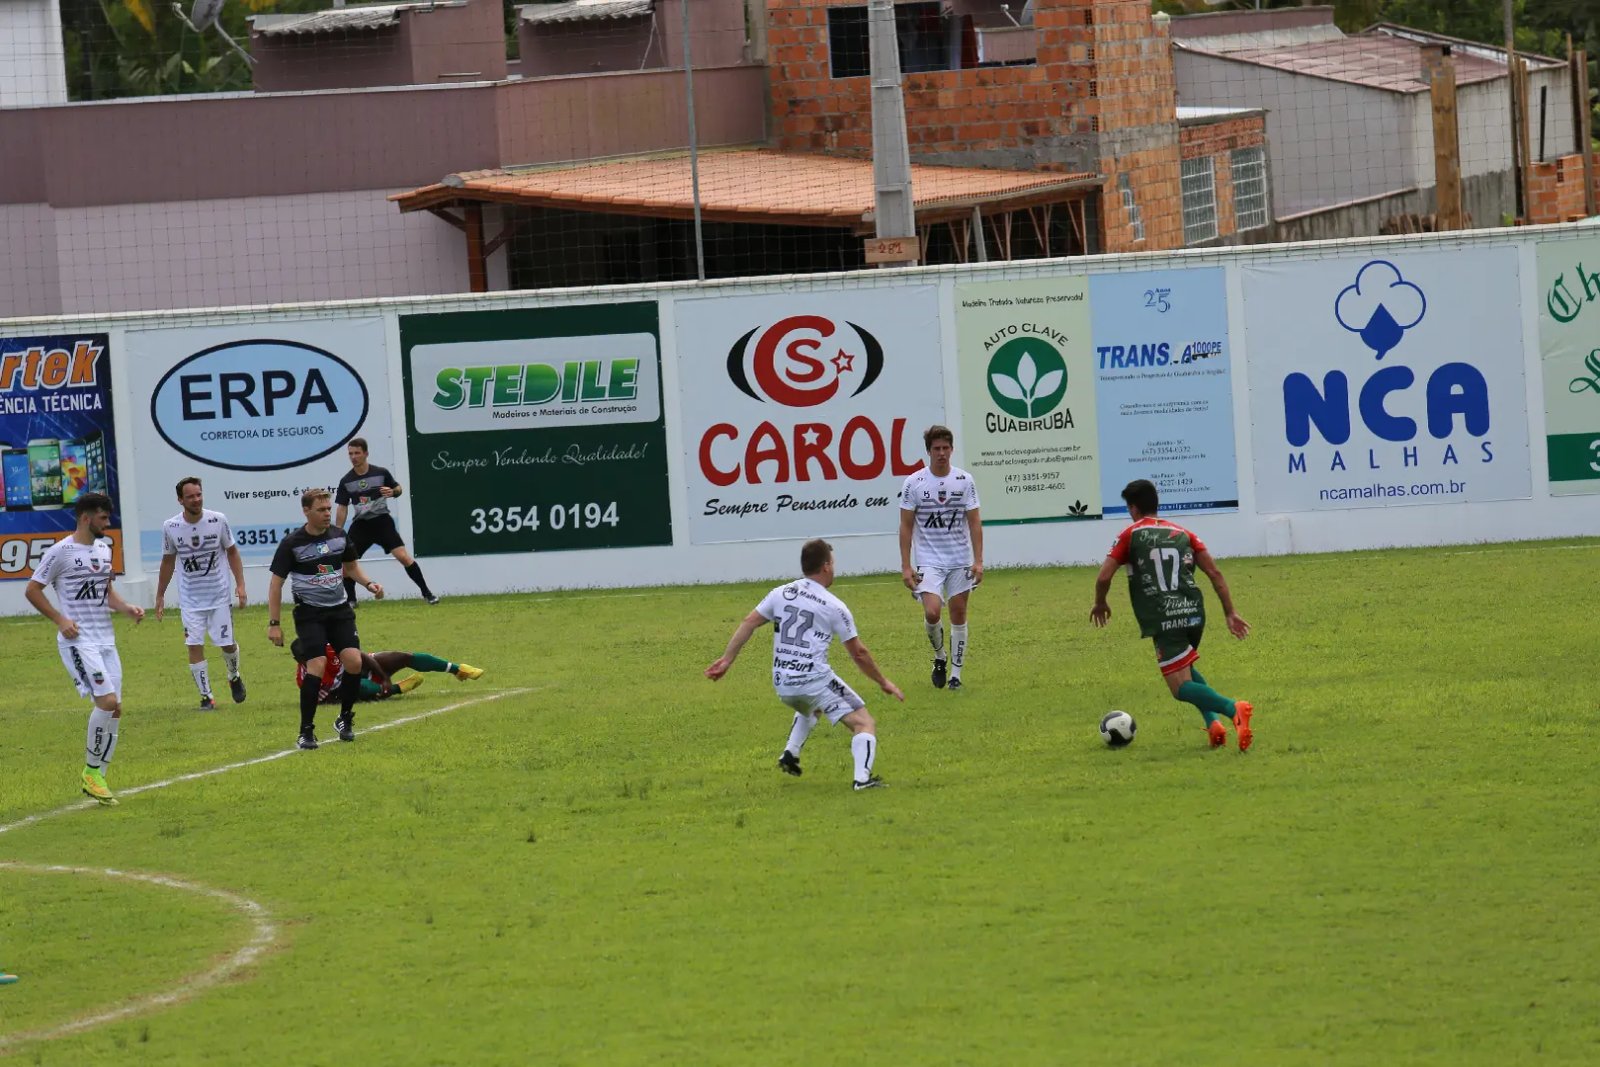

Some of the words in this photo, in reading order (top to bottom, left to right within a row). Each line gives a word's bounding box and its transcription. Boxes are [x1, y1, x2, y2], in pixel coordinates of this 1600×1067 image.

[1143, 289, 1171, 313] 25
[983, 324, 1018, 351] AUTO
[1021, 322, 1069, 347] CLAVE
[180, 368, 339, 421] ERPA
[432, 357, 640, 410] STEDILE
[42, 391, 102, 412] TÉCNICA
[492, 410, 530, 419] Madeiras
[540, 407, 577, 416] Materiais
[579, 406, 590, 415] de
[591, 404, 637, 415] Construção
[1283, 362, 1490, 447] NCA
[200, 429, 259, 441] CORRETORA
[262, 428, 275, 438] DE
[277, 425, 324, 437] SEGUROS
[985, 408, 1075, 433] GUABIRUBA
[431, 450, 489, 474] Sempre
[493, 446, 558, 466] Vendendo
[562, 442, 648, 465] Qualidade!
[698, 415, 925, 487] CAROL
[1288, 442, 1494, 474] MALHAS
[1004, 473, 1021, 483] (47)
[1005, 485, 1021, 495] (47)
[1319, 480, 1466, 500] ncamalhas.com.br
[224, 490, 250, 500] Viver
[252, 489, 290, 500] seguro,
[292, 486, 299, 496] é
[703, 498, 769, 518] Sempre
[776, 493, 859, 513] Pensando
[864, 494, 890, 507] em
[470, 505, 540, 534] 3354
[549, 501, 620, 530] 0194
[237, 528, 278, 545] 3351
[1149, 547, 1180, 592] 17
[220, 624, 229, 639] 2
[780, 604, 815, 649] 22
